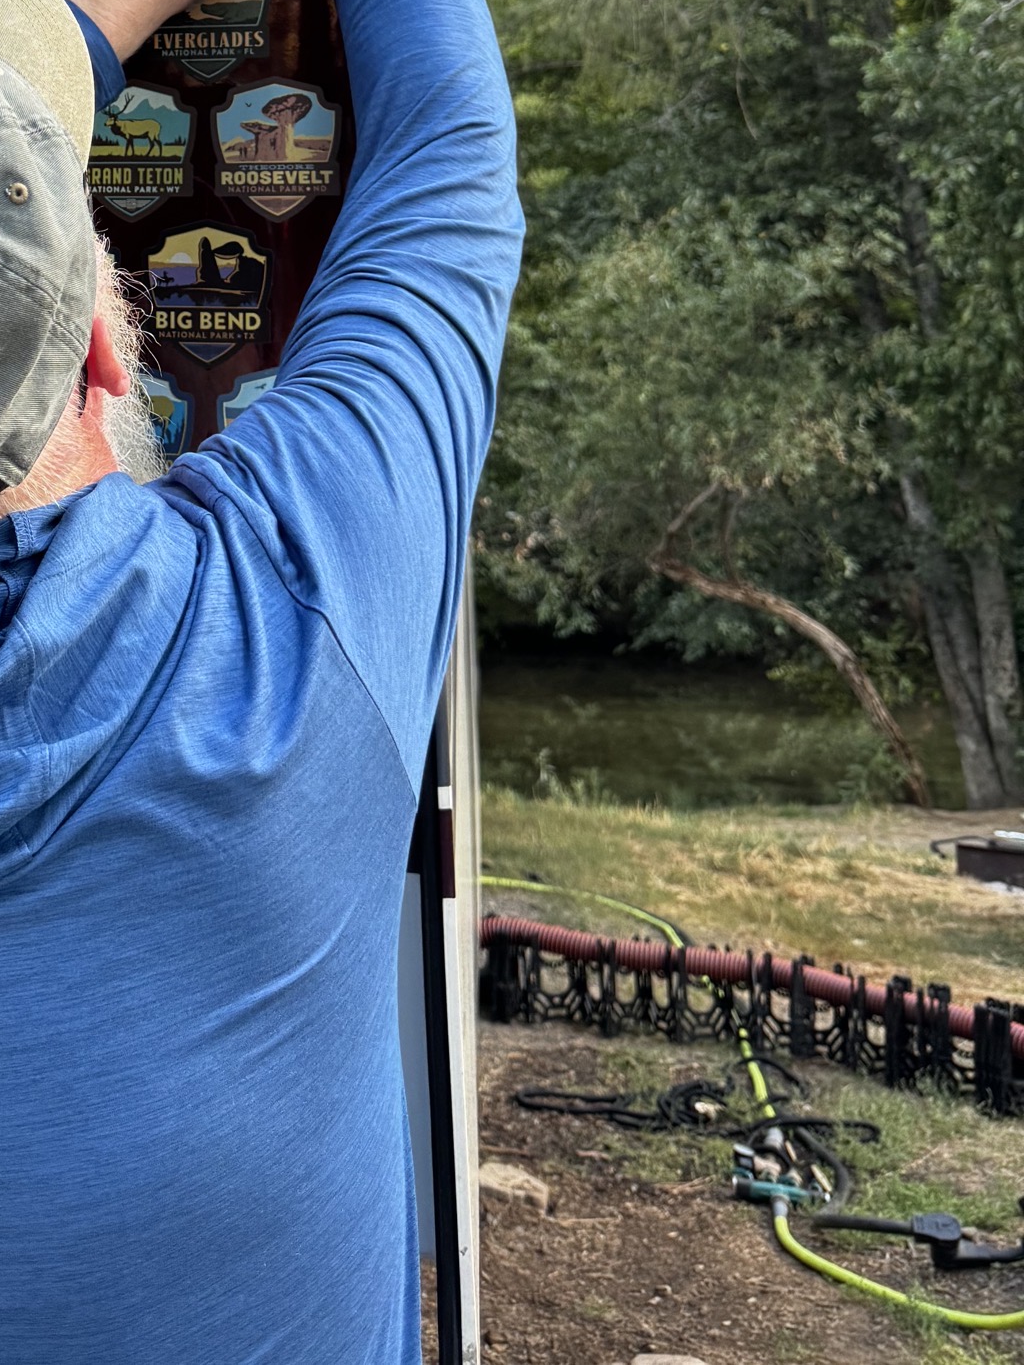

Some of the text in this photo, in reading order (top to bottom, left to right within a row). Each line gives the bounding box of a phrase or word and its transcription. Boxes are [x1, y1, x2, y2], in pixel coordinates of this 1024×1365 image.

[153, 30, 264, 50] EVERGLADES
[161, 48, 208, 57] NATIONAL
[244, 47, 254, 55] FL
[87, 167, 183, 185] RAND TETON
[221, 170, 333, 185] ROOSEVELT
[228, 185, 276, 193] NATIONAL
[156, 311, 261, 331] BIG BEND
[158, 331, 207, 339] NATIONAL
[243, 332, 255, 340] TX
